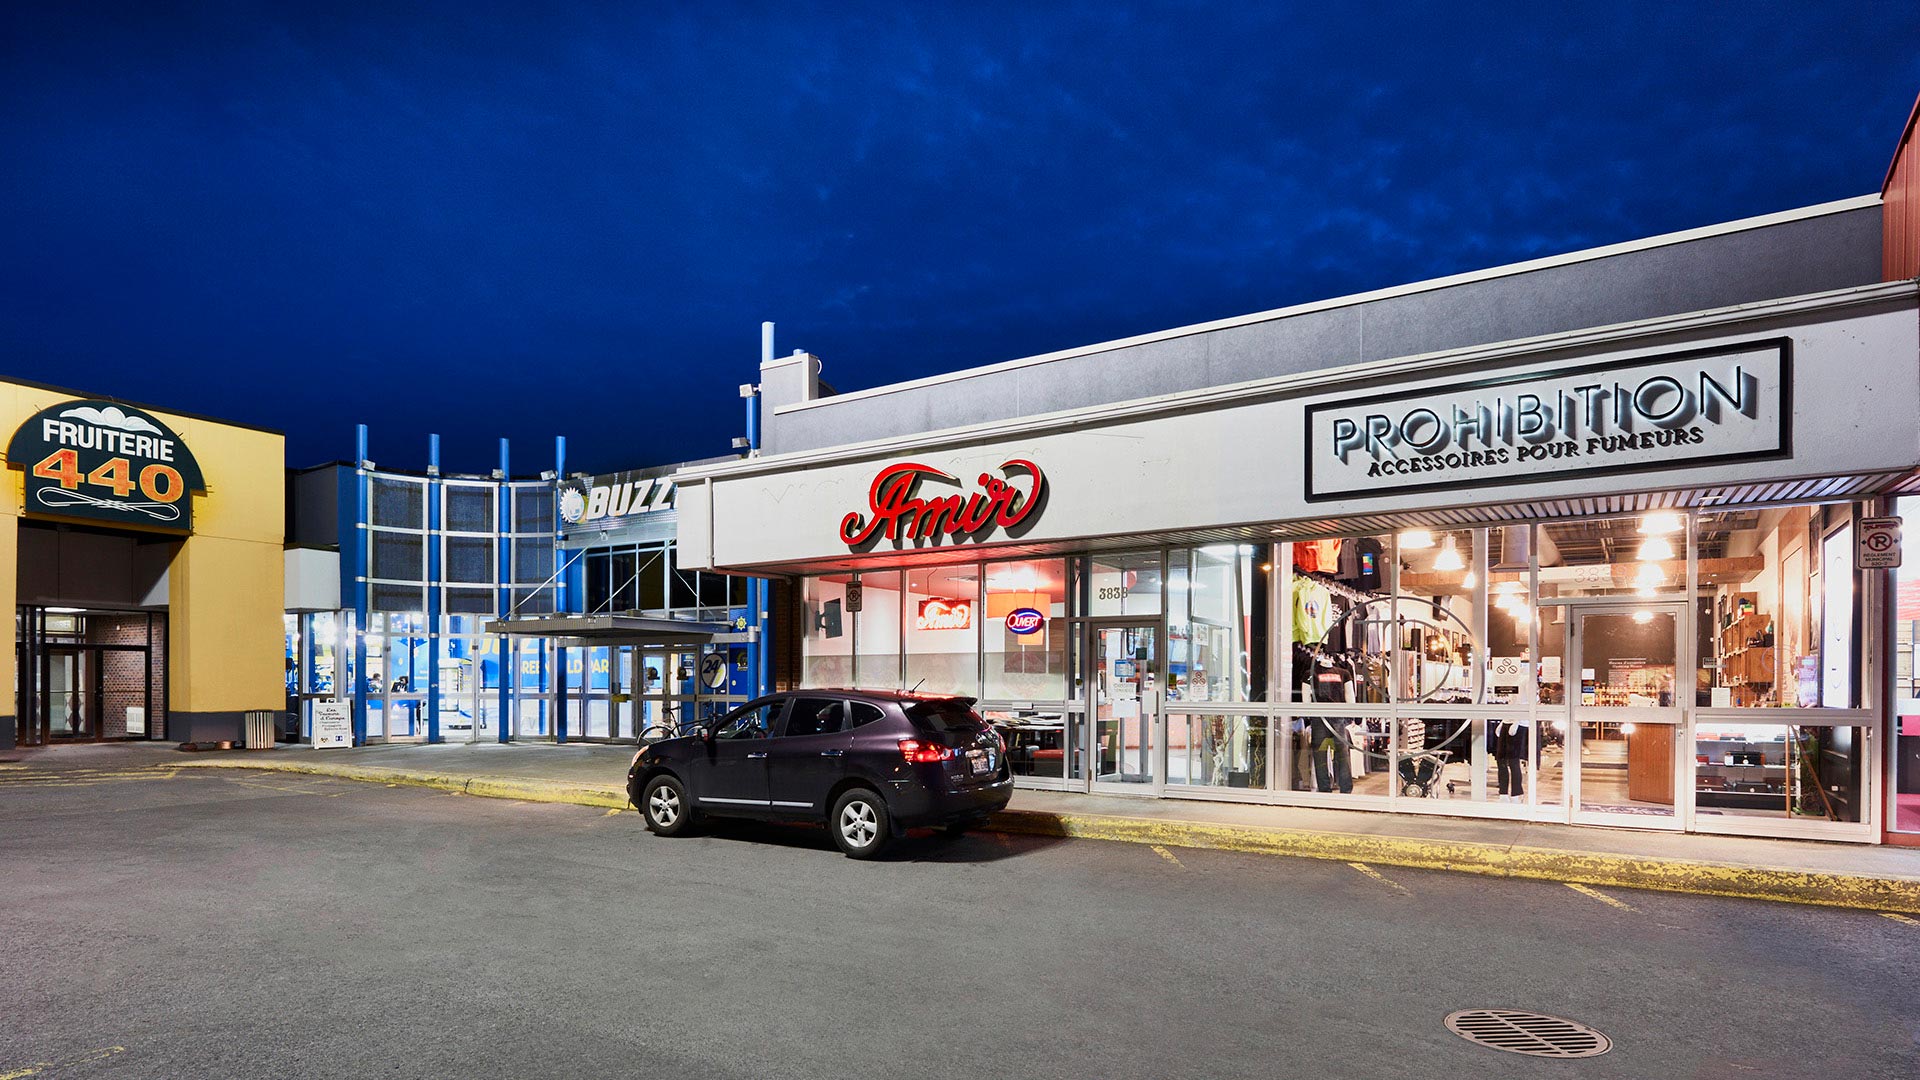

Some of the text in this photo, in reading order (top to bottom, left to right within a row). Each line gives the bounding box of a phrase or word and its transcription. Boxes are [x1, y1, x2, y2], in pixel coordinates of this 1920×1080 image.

[1332, 365, 1744, 457] PROHIBITION
[43, 418, 174, 462] FRUITERIE
[1366, 426, 1704, 478] ACCESSOIRES POUR FUMEURS
[32, 447, 184, 504] 440
[586, 476, 679, 520] BUZZ
[839, 458, 1043, 546] Amir
[1007, 614, 1041, 629] OUVERT
